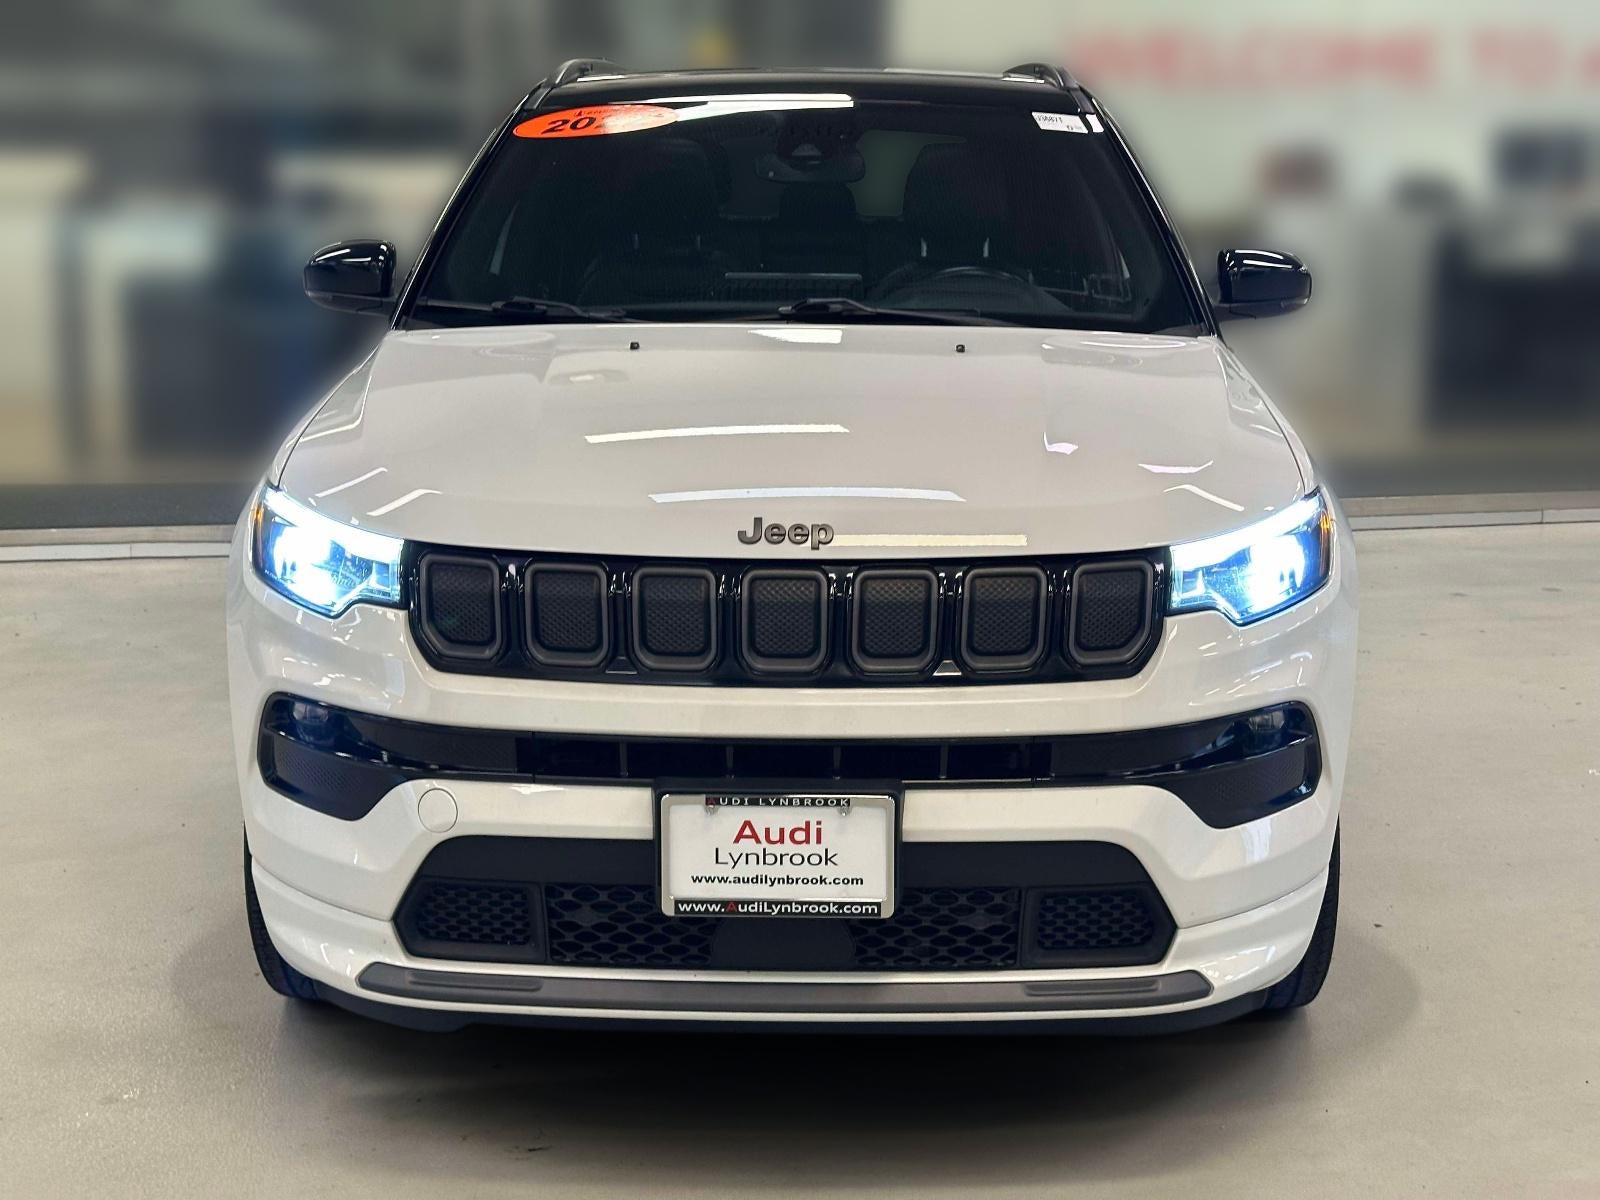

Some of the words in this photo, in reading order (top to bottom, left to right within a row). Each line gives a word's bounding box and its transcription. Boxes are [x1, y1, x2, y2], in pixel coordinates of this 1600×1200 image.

[737, 516, 835, 551] Jeep
[706, 796, 749, 806] AUDI
[759, 796, 850, 807] LYNBROOK
[733, 819, 823, 845] Audi
[714, 847, 839, 870] Lynbrook
[691, 873, 864, 887] www.audilynbrook.com
[678, 900, 878, 915] www.AudiLynbrook.com
